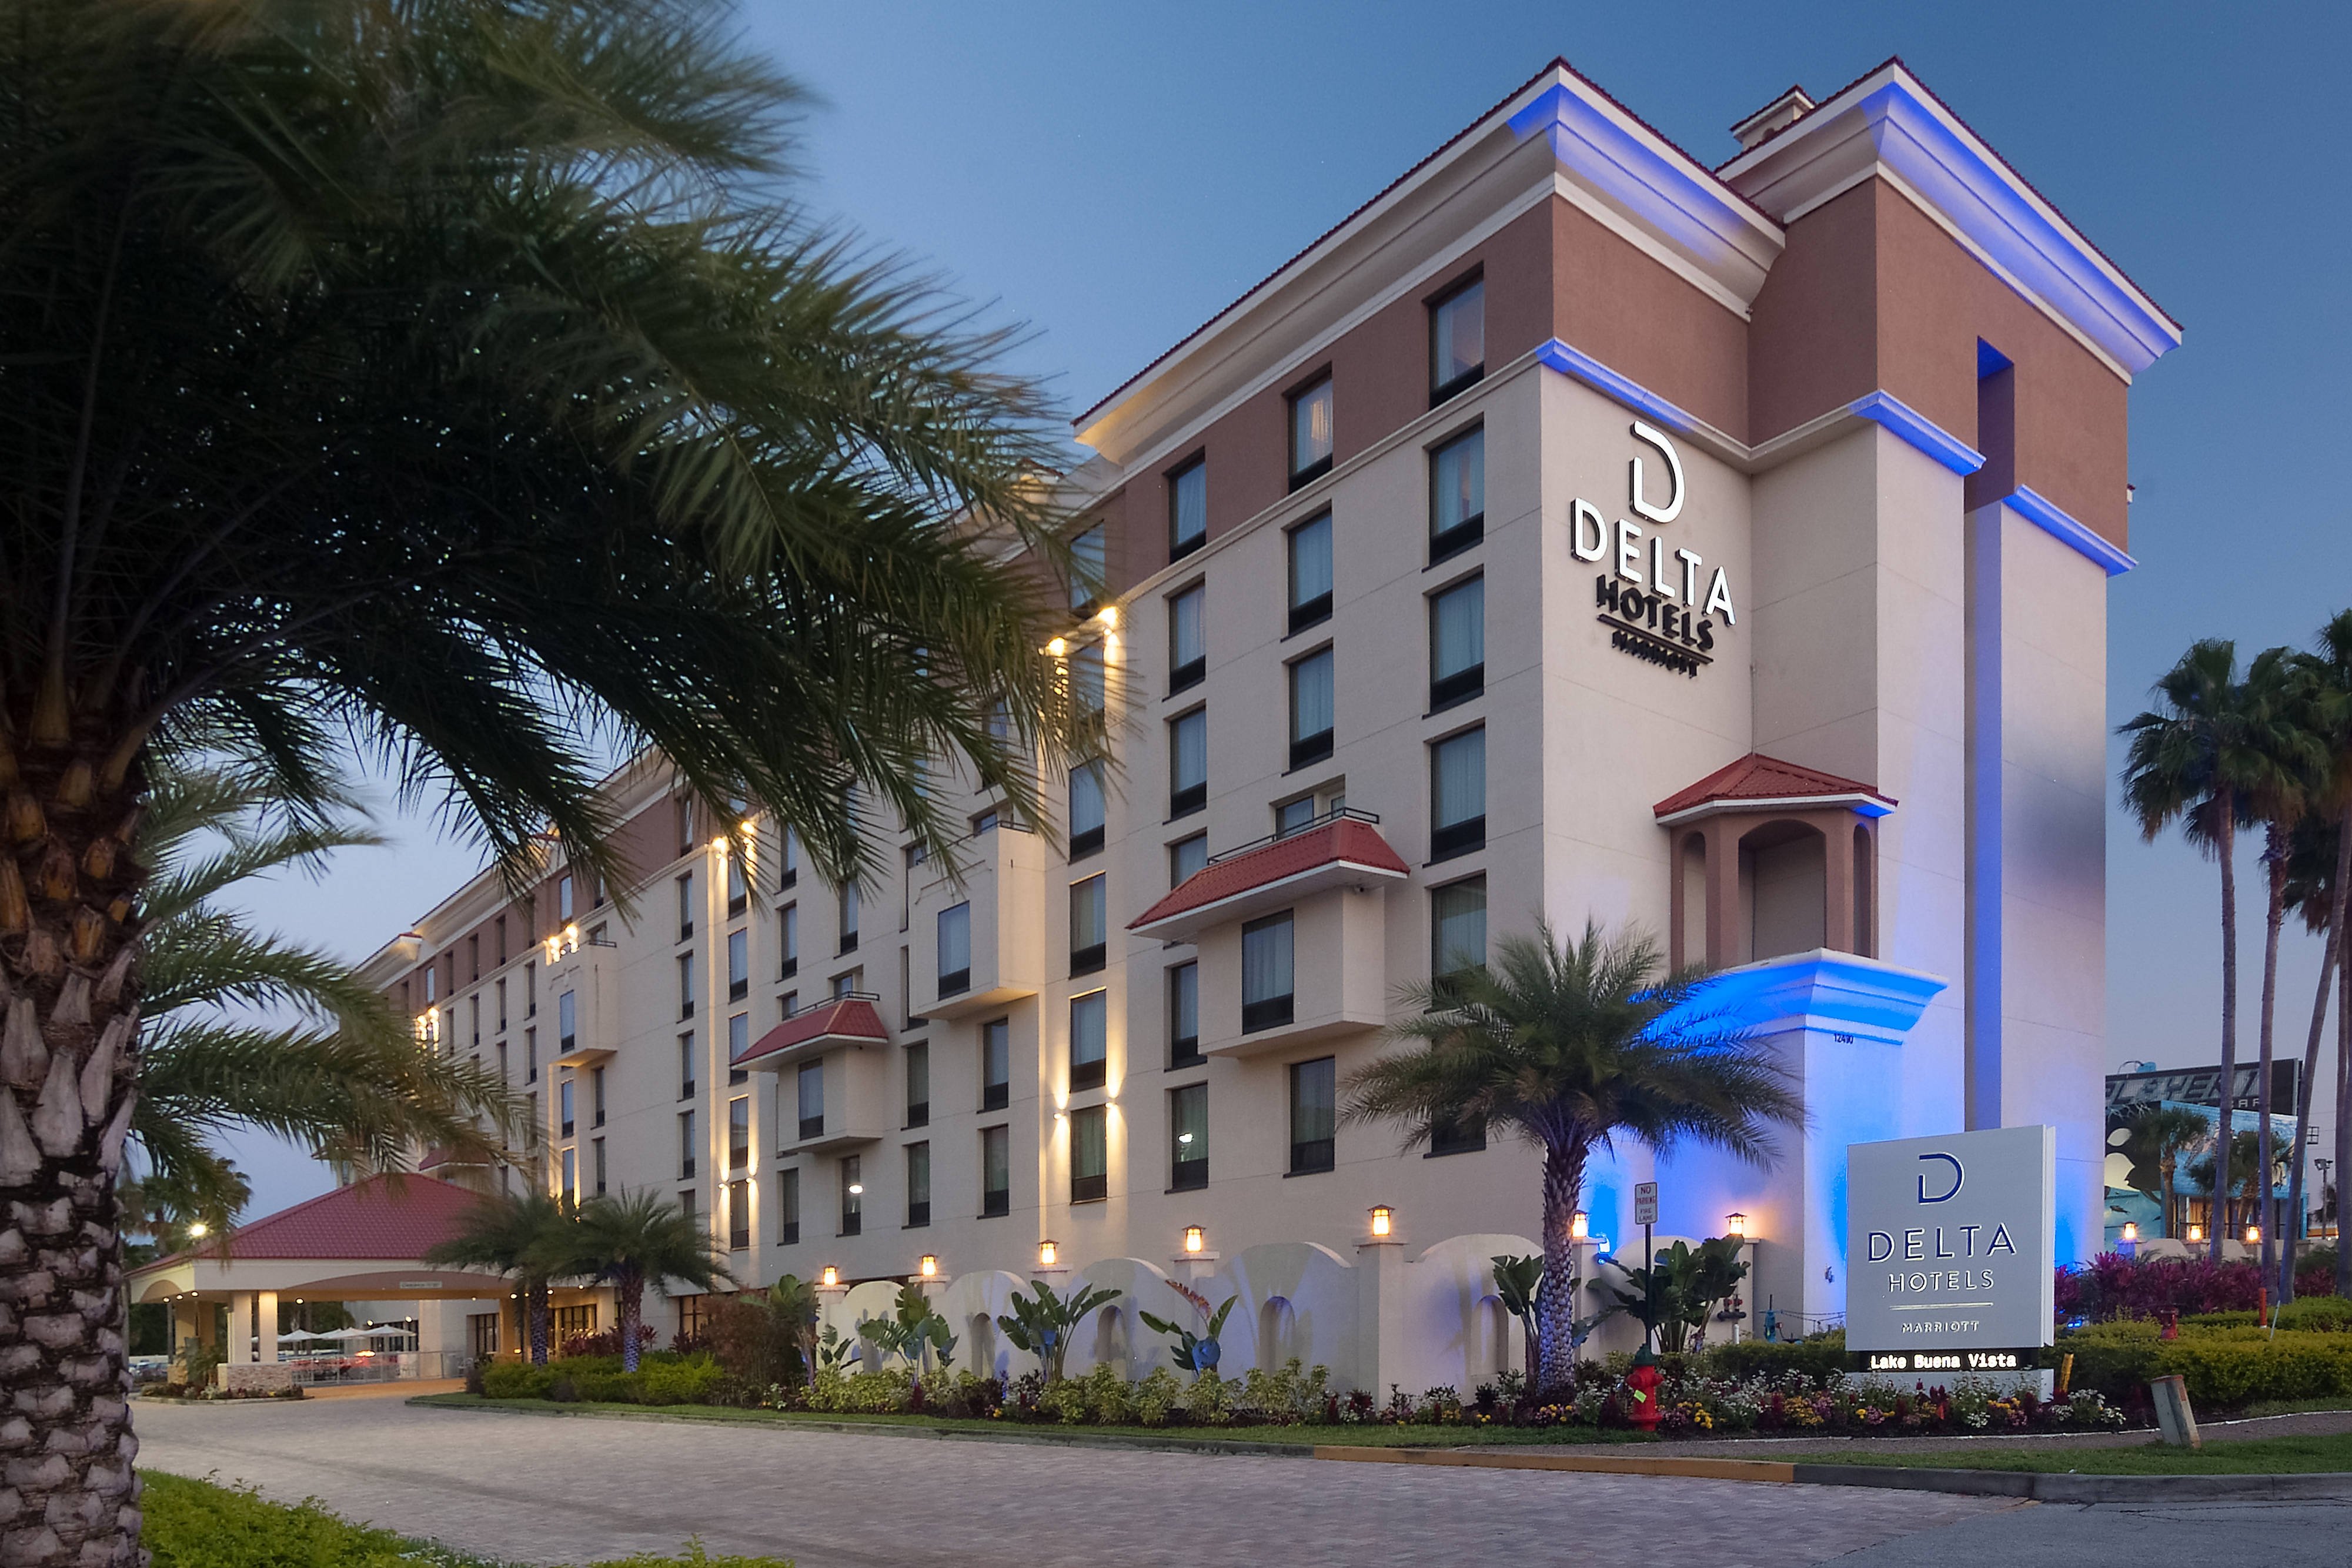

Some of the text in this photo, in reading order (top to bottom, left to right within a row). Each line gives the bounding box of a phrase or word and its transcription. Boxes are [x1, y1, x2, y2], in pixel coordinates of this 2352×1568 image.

[1571, 497, 1736, 627] DELTA
[1596, 574, 1714, 651] HOTELS
[1636, 1196, 1656, 1204] PARKING
[1641, 1186, 1651, 1194] NO
[1868, 1222, 2017, 1263] DELTA
[1889, 1269, 1994, 1293] HOTELS
[1902, 1320, 1980, 1333] MARRIOTT
[1870, 1352, 2017, 1369] Lake Buena Vista
